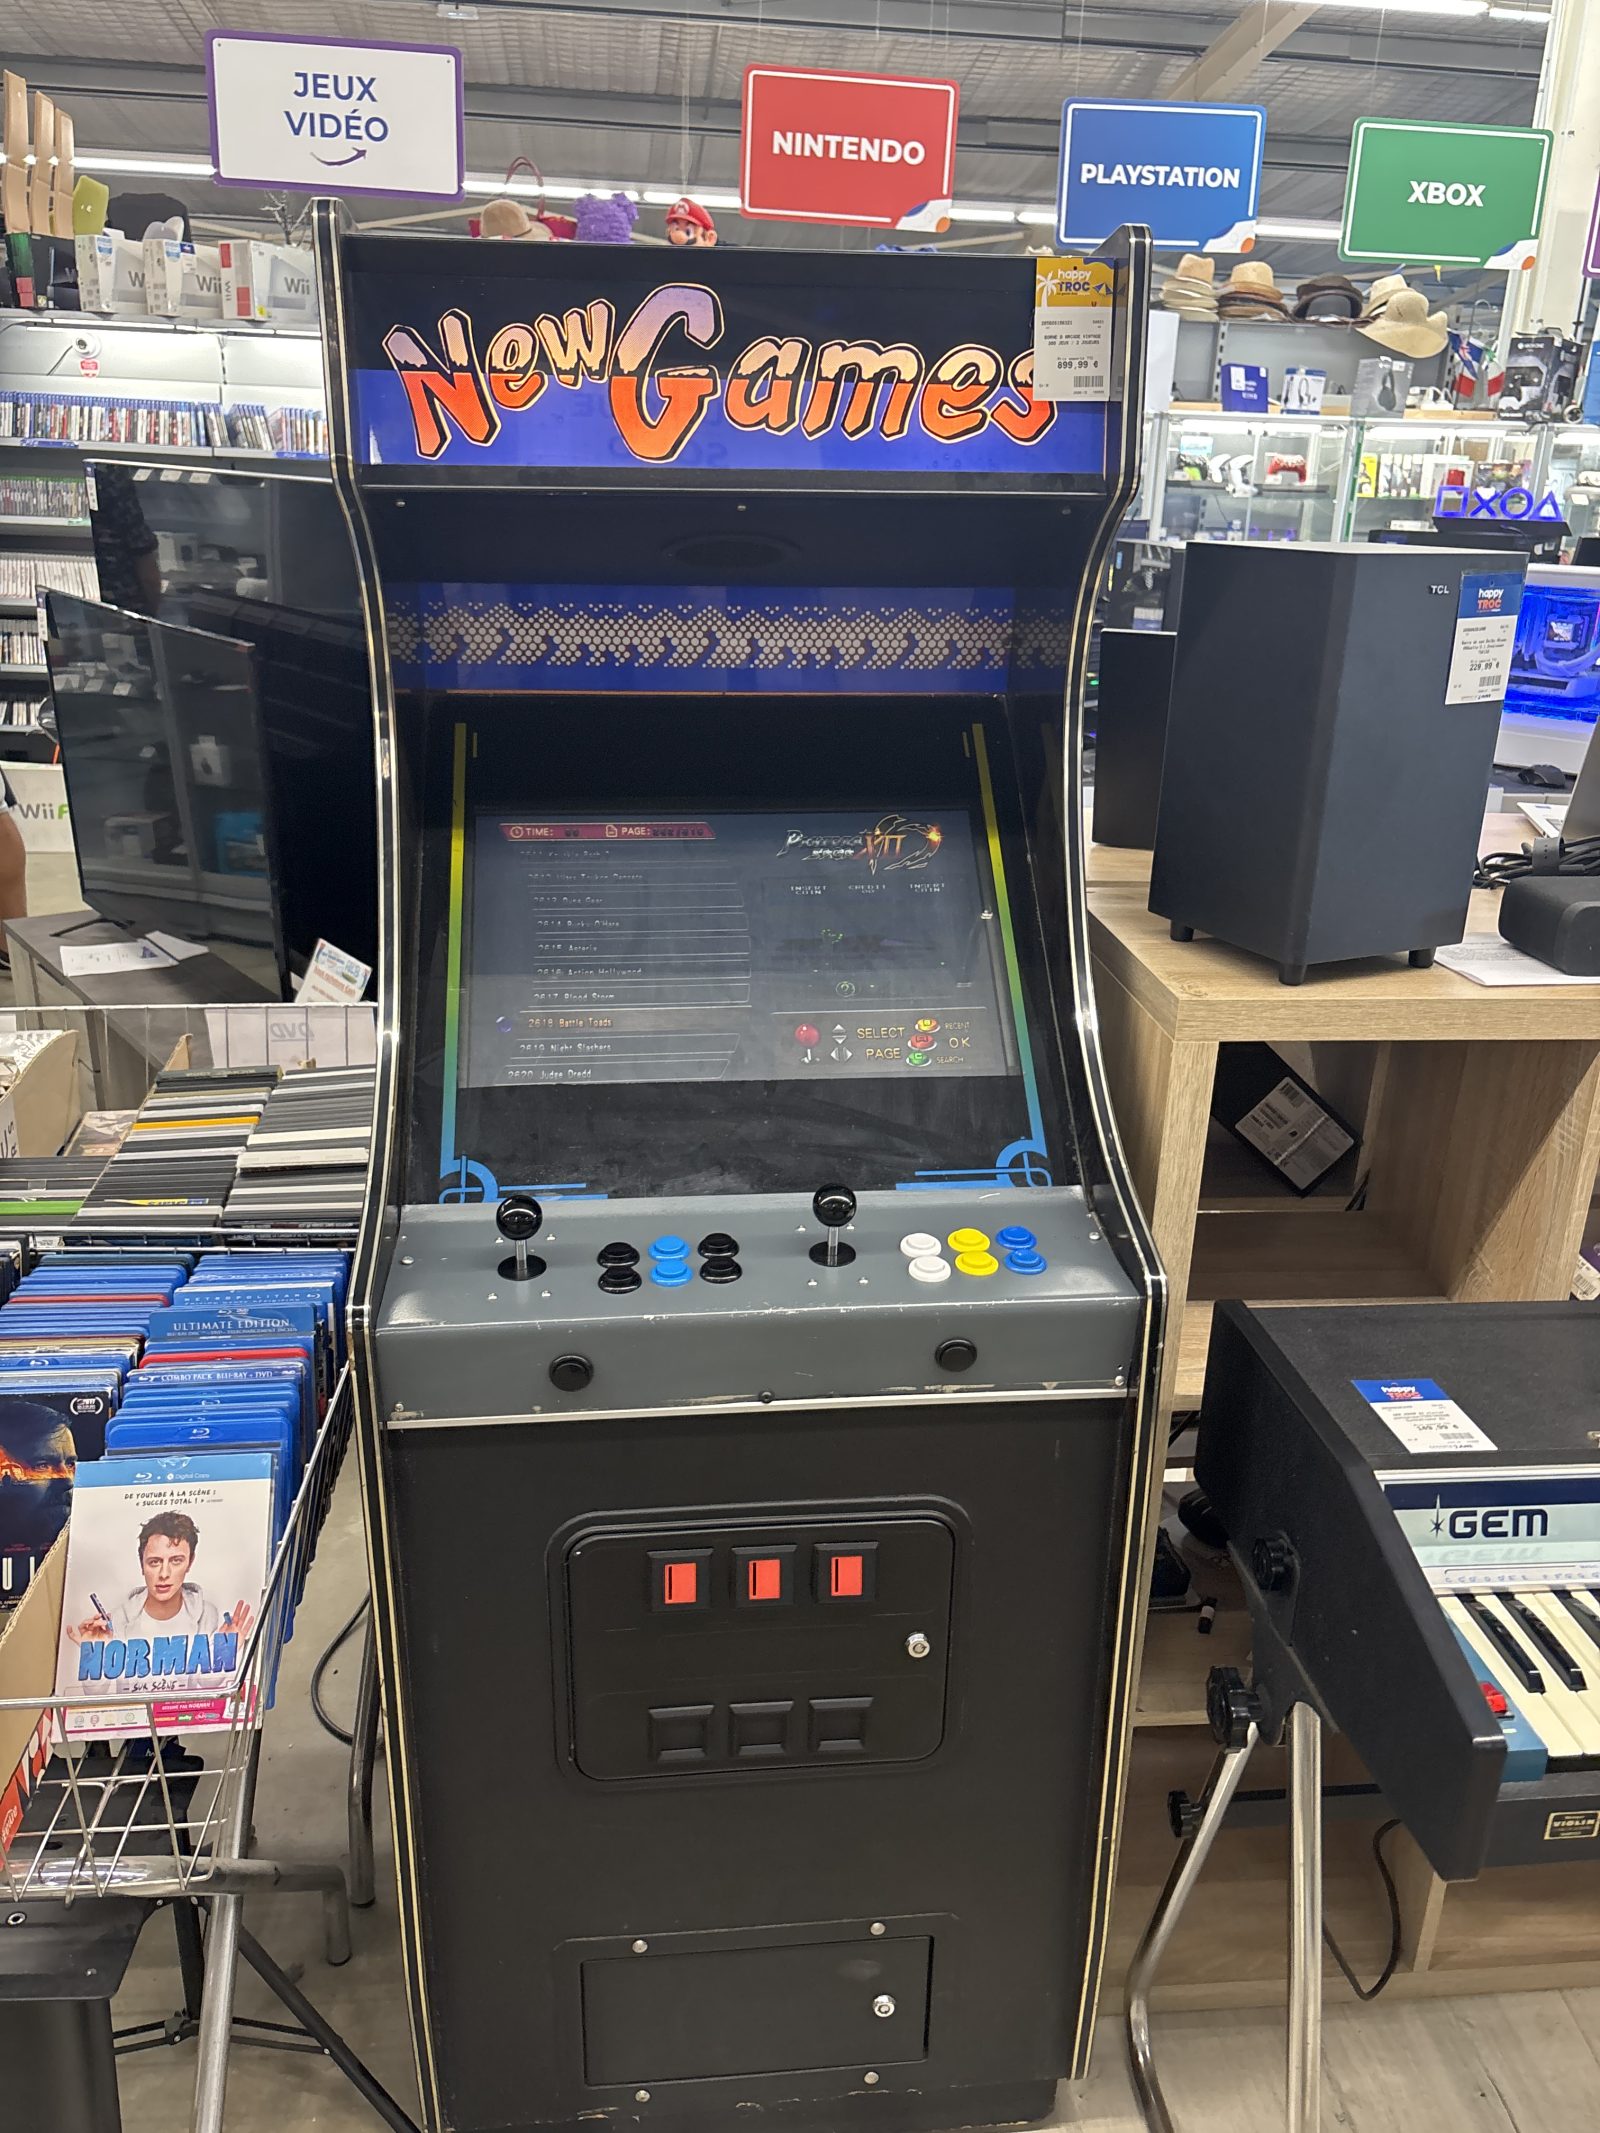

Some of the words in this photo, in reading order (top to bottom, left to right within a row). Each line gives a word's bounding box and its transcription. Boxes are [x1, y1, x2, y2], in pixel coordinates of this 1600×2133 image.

[293, 72, 378, 102] JEUX
[283, 108, 389, 142] VIDÉO
[772, 130, 926, 166] NINTENDO
[1080, 162, 1240, 189] PLAYSTATION
[1407, 180, 1486, 207] XBOX
[1057, 268, 1092, 281] happy
[284, 276, 311, 295] Wii
[1058, 281, 1091, 292] TROC
[1057, 360, 1089, 370] 899,99
[383, 298, 616, 459] New
[608, 283, 1058, 463] Games
[1431, 586, 1450, 594] TCL
[1478, 588, 1504, 602] happy
[1477, 600, 1502, 609] TROC
[17, 803, 55, 820] Wii
[57, 803, 69, 820] F
[525, 827, 554, 837] TIME:
[621, 826, 651, 836] PAGE:
[568, 968, 594, 976] Action
[598, 967, 642, 976] Hollywood
[559, 1018, 584, 1028] Battle
[588, 1017, 613, 1027] Toads
[857, 1027, 906, 1039] SELECT
[550, 1043, 573, 1053] Night
[577, 1043, 612, 1052] Slashers
[948, 1036, 971, 1049] OK
[865, 1047, 901, 1059] PAGE
[936, 1055, 964, 1064] SEARCH
[540, 1070, 563, 1080] Judge
[567, 1069, 592, 1079] Dredd
[173, 1319, 233, 1331] ULTIMATE
[237, 1318, 290, 1328] EDITION
[161, 1373, 192, 1382] COMBO
[193, 1372, 212, 1381] PACK
[216, 1371, 248, 1379] BLU-RAY
[255, 1370, 273, 1379] DVD
[135, 1491, 167, 1499] YOUTUBE
[169, 1489, 175, 1497] À
[189, 1488, 211, 1496] SCÈNE
[170, 1497, 193, 1505] TOTAL
[1449, 1508, 1548, 1539] GEM
[78, 1632, 239, 1681] NORMAN
[133, 1681, 149, 1692] SUR
